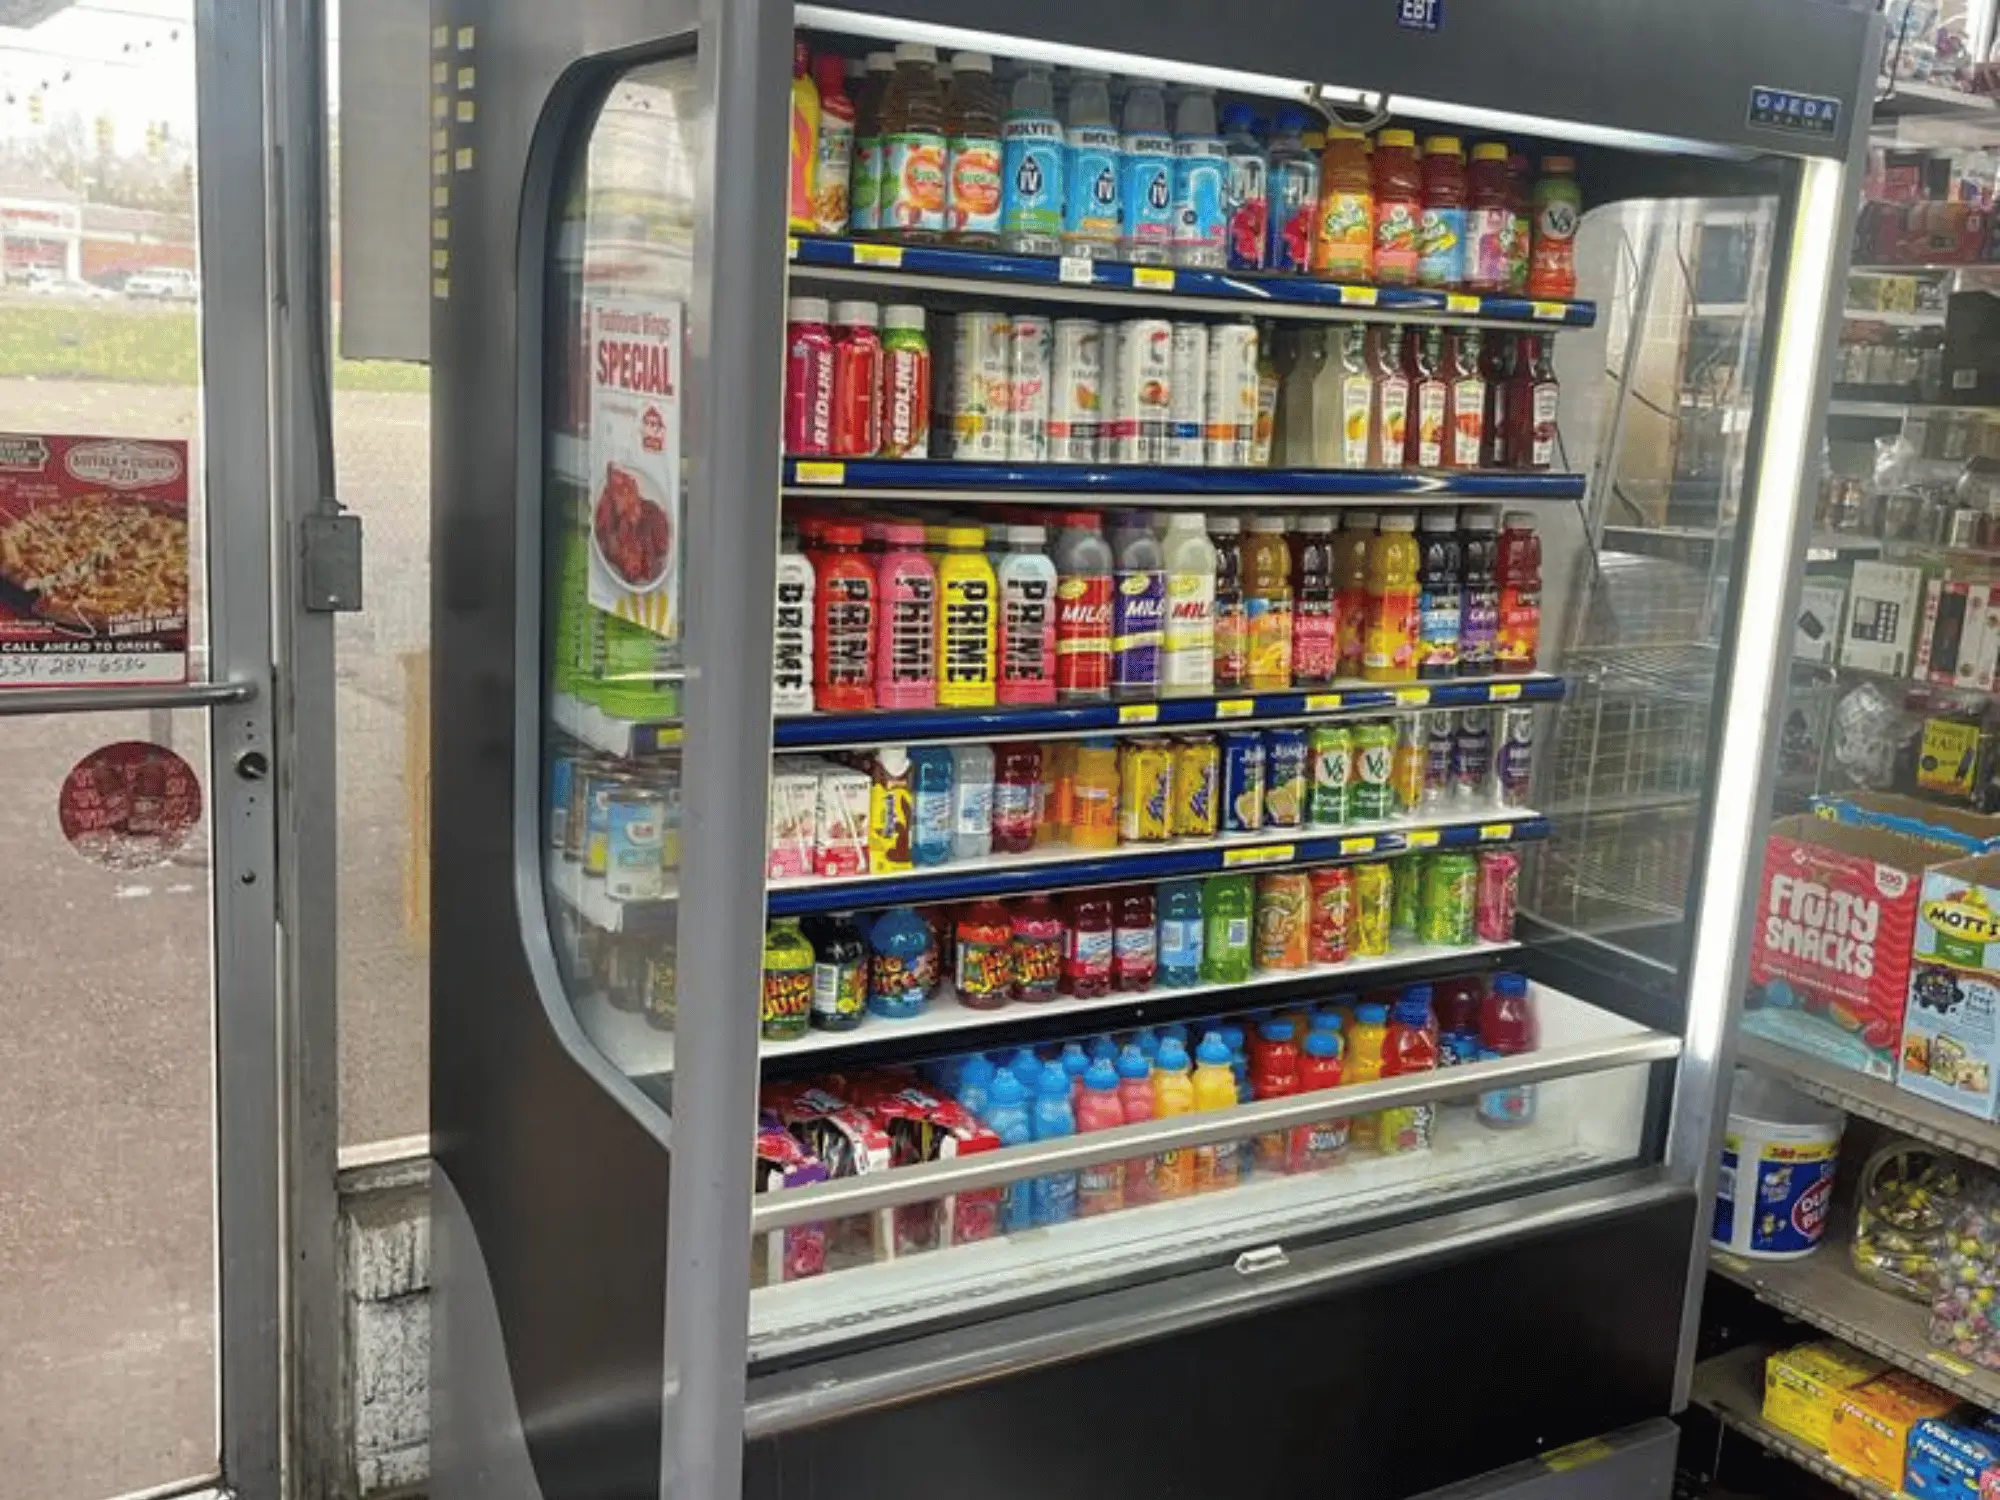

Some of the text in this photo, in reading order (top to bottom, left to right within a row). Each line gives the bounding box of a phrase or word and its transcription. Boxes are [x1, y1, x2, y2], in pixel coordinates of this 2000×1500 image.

[1402, 0, 1434, 22] EBT
[1756, 93, 1834, 121] OJEDA
[596, 339, 673, 396] SPECIAL
[814, 350, 834, 447] REDLINE
[2, 641, 162, 652] CALL AHEAD TO ORDER
[827, 578, 871, 684] PRIME
[891, 577, 932, 683] PRIME
[946, 579, 989, 683] PRIME
[1004, 578, 1048, 681] PRIME
[1770, 873, 1879, 942] FRUITY
[1764, 916, 1875, 979] SNACKS
